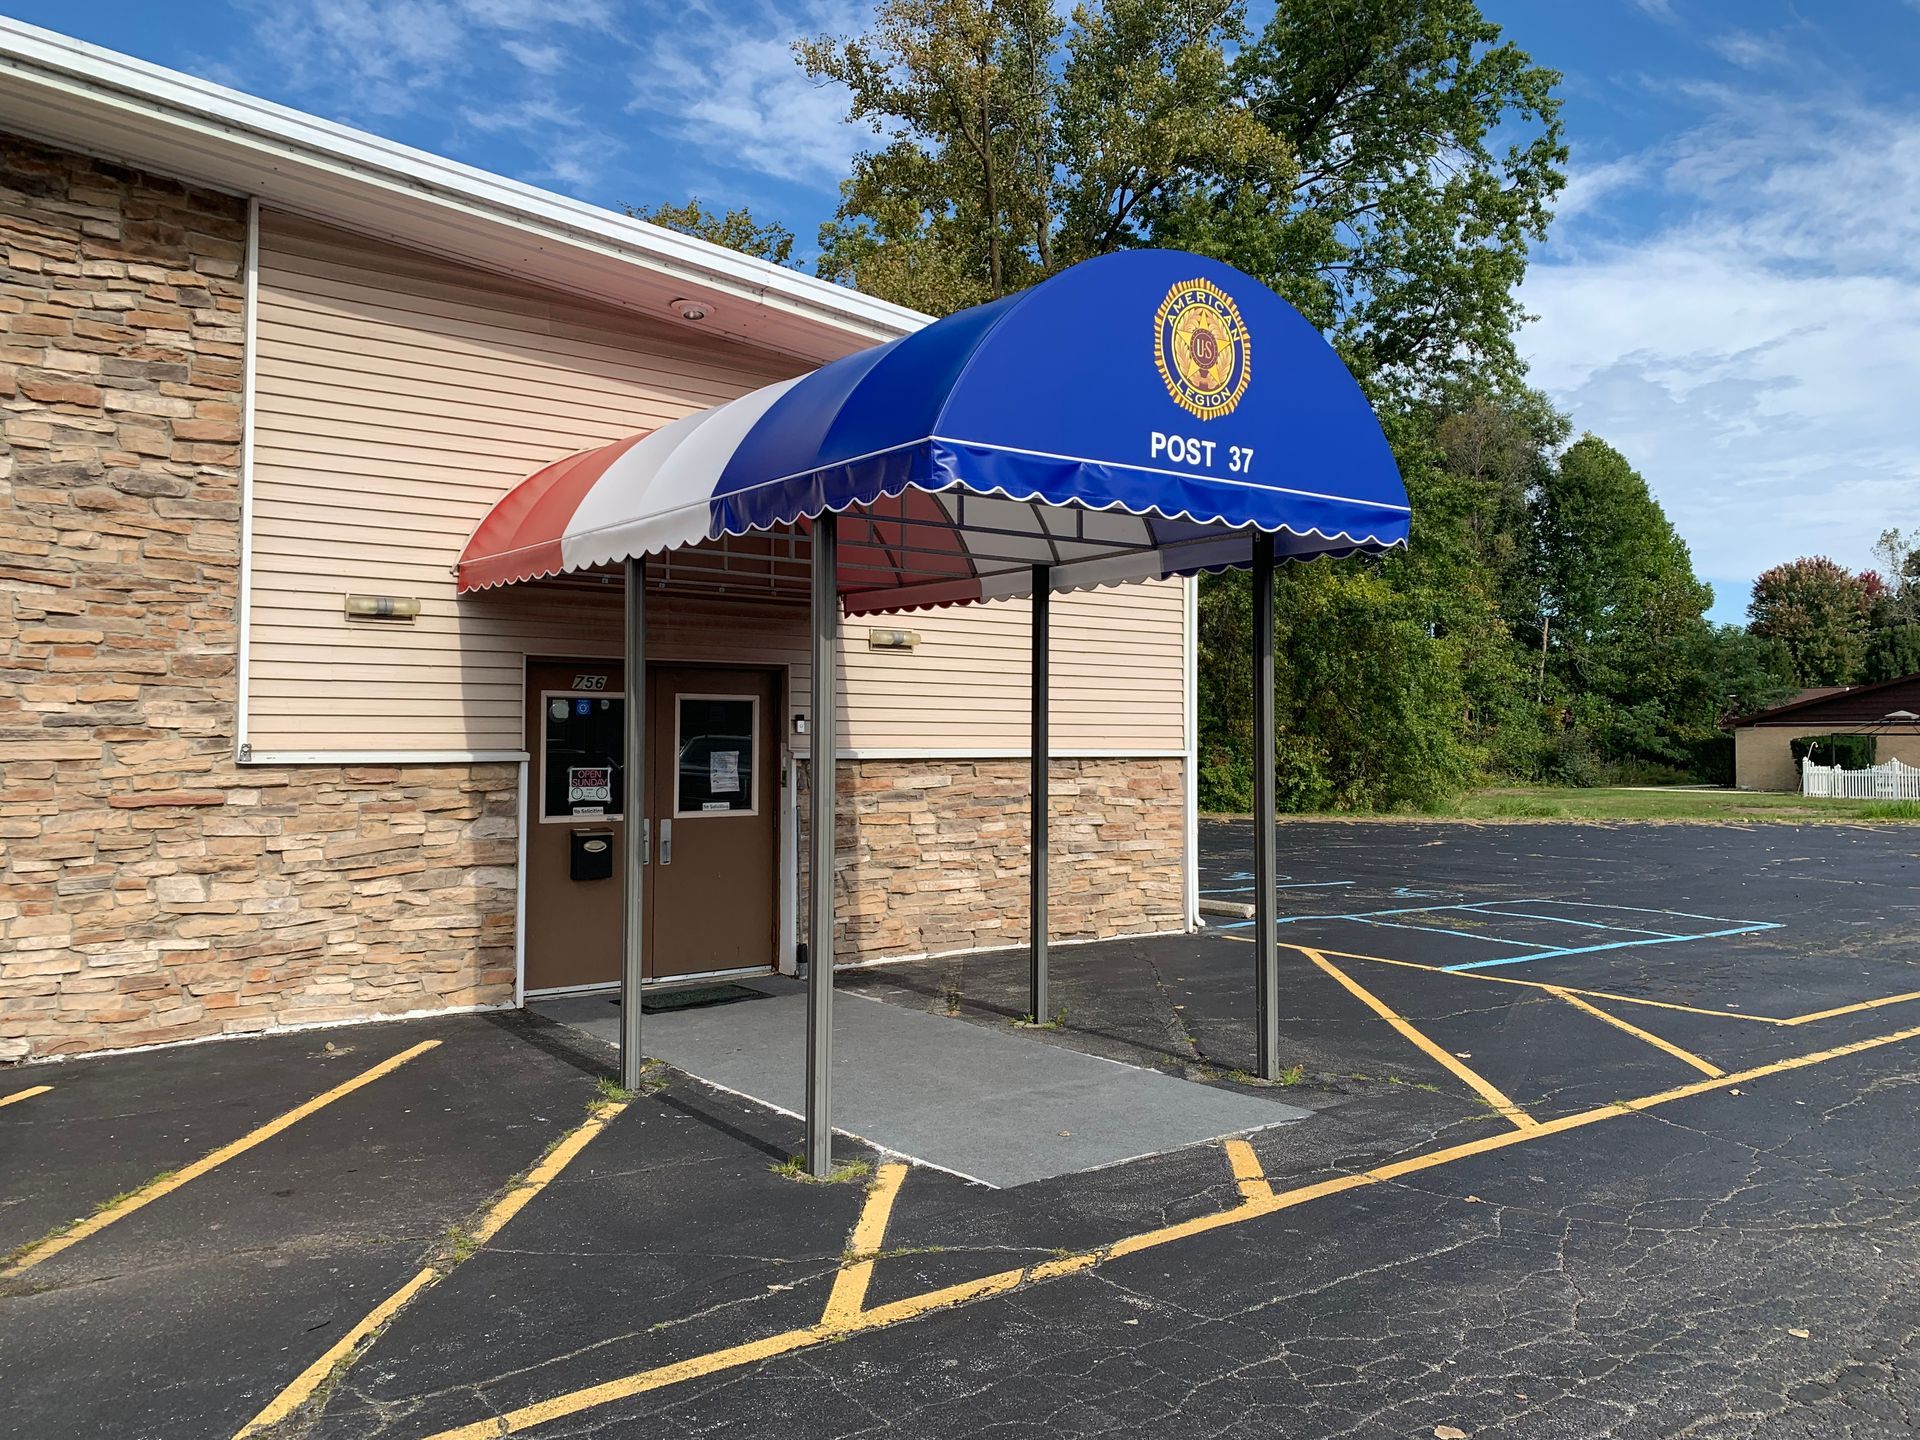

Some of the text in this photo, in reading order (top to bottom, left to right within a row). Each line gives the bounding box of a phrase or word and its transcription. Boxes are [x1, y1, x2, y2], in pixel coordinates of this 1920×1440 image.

[1167, 292, 1240, 342] AMERICAN
[1176, 378, 1231, 407] LEGION
[1151, 431, 1254, 473] POST 37
[574, 676, 605, 689] 756
[572, 778, 608, 787] SUNDAY
[577, 770, 602, 779] OPEN
